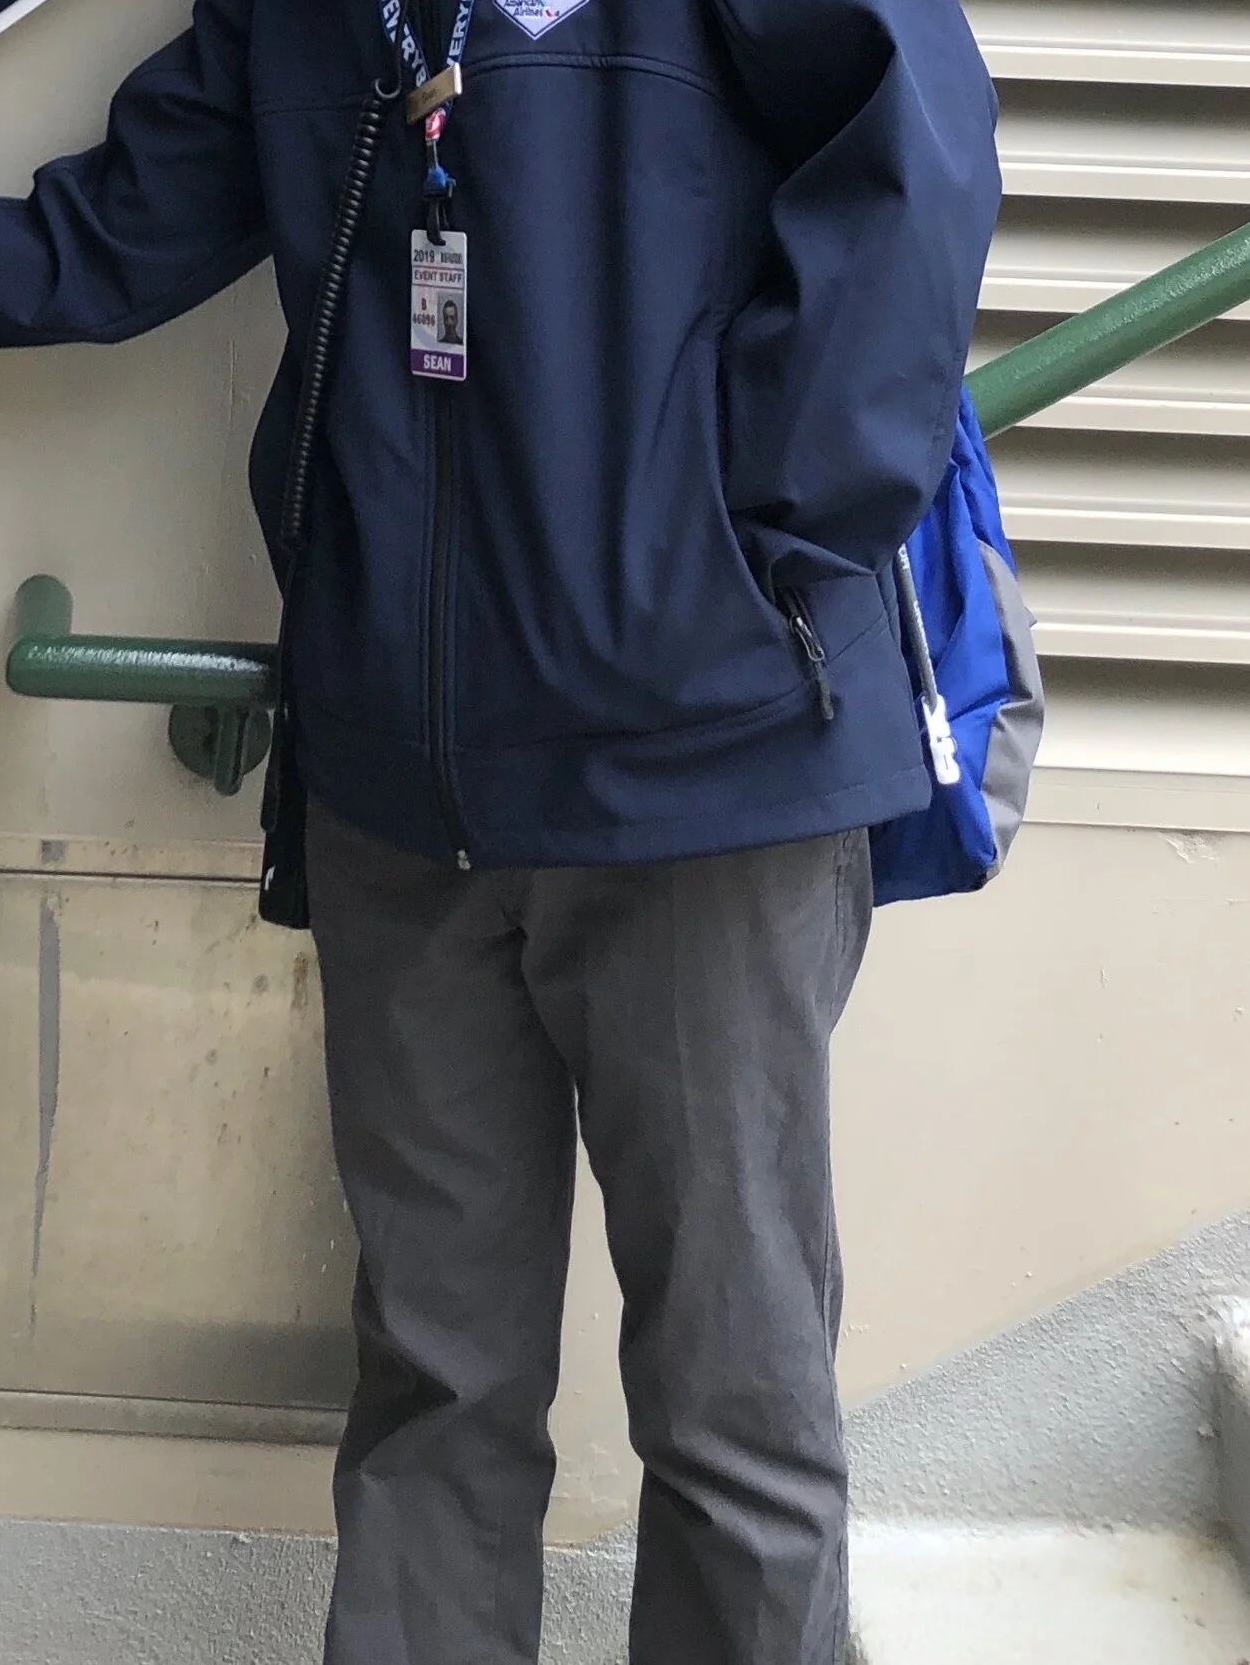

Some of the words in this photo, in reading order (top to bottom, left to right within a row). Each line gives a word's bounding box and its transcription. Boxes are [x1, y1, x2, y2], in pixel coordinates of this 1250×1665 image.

[413, 249, 435, 263] 2019
[414, 269, 438, 282] EVENT
[439, 271, 462, 284] STAFF
[423, 353, 452, 372] SEAN
